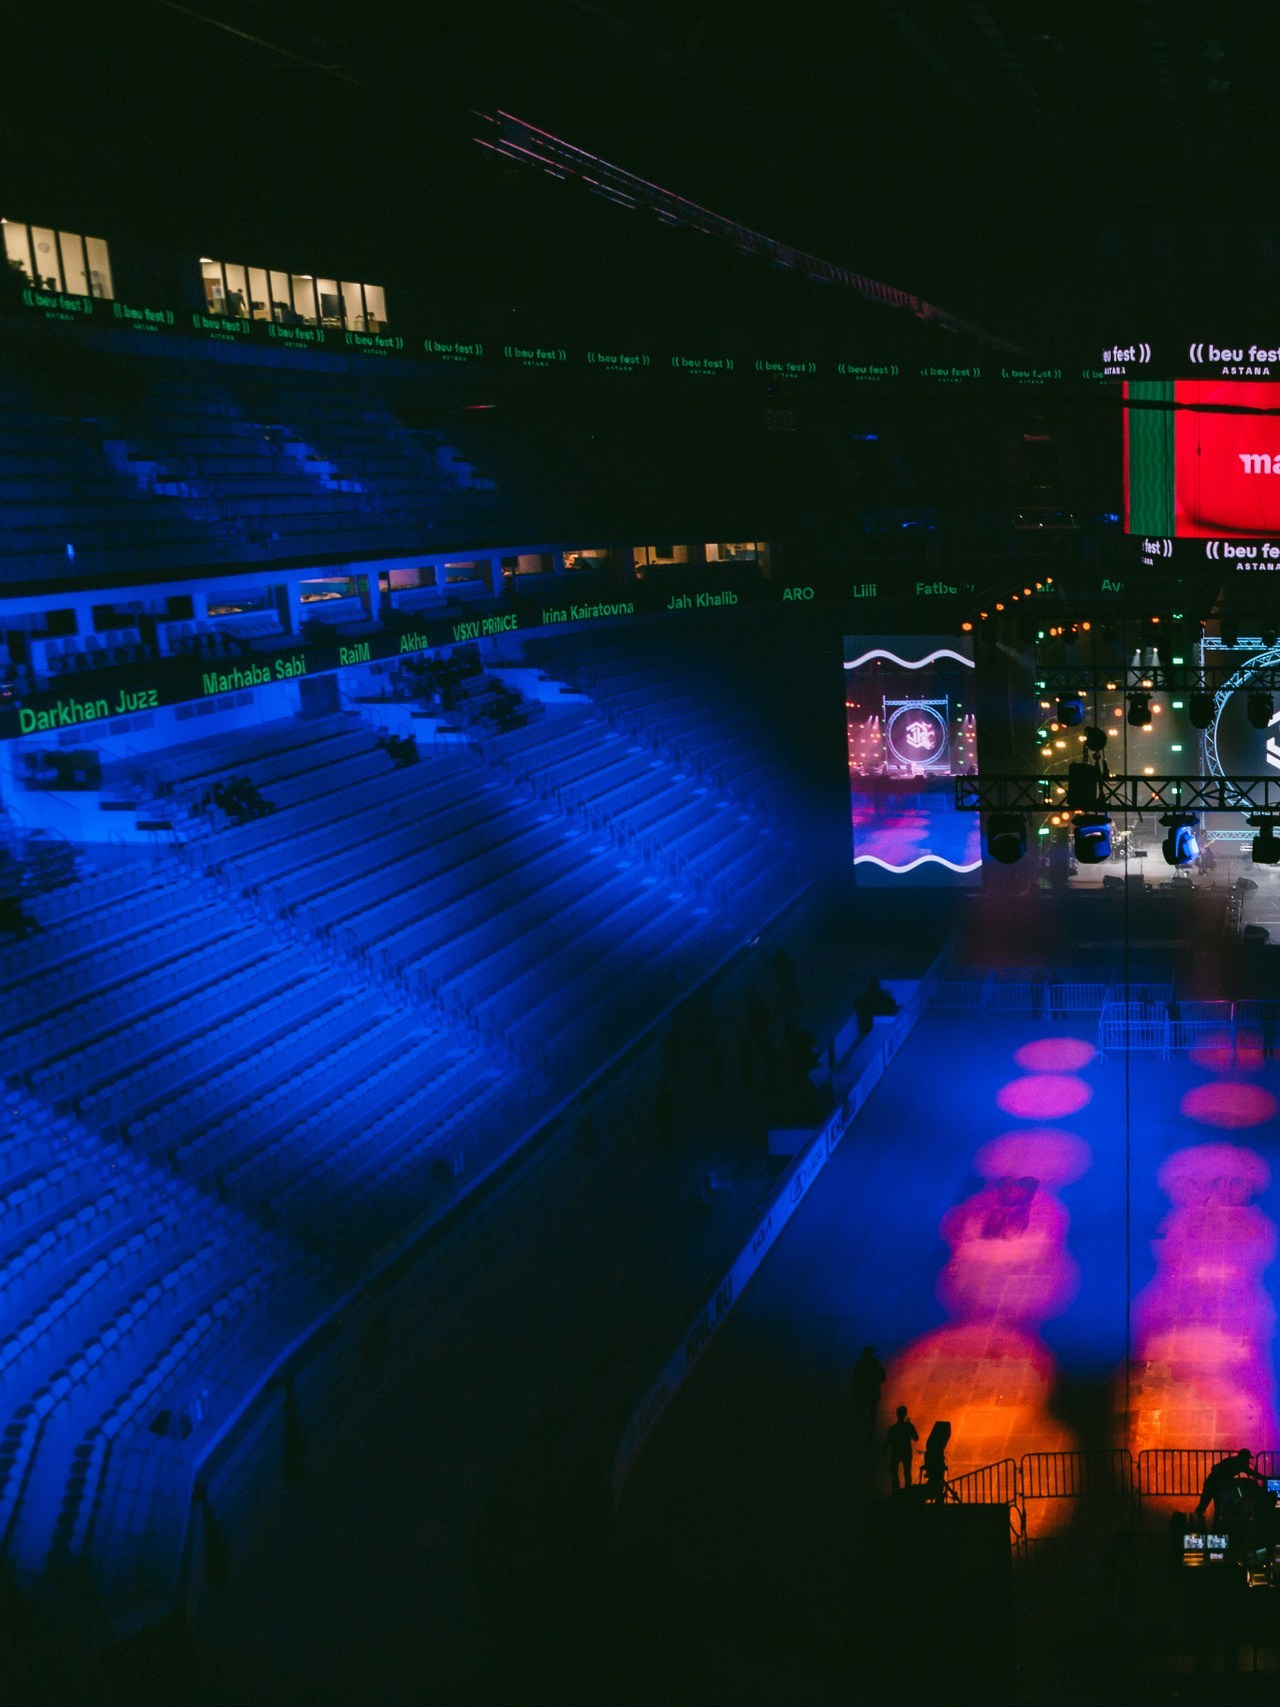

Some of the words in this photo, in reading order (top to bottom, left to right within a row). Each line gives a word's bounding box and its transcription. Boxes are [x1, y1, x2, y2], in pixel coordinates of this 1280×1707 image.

[59, 294, 82, 311] fest
[145, 310, 165, 322] fest
[222, 320, 241, 332] fest
[298, 329, 315, 340] fest
[375, 336, 394, 348] fest
[455, 342, 475, 355] fest
[536, 349, 557, 360] fest
[1113, 345, 1136, 362] fest
[1208, 344, 1244, 362] beu
[619, 354, 640, 365] fest
[703, 357, 724, 369] fest
[785, 361, 807, 372] fest
[869, 364, 889, 375] fest
[1221, 366, 1271, 376] ASTANA
[1145, 538, 1161, 555] fest
[1223, 542, 1257, 559] beu
[782, 587, 815, 601] ARO
[853, 583, 877, 598] Liili
[667, 593, 692, 610] Jah
[696, 590, 739, 608] Khalib
[542, 608, 568, 625] Irina
[570, 602, 635, 621] Kairatovna
[452, 619, 481, 642] V$XV
[482, 614, 519, 636] PRiNCE
[400, 632, 428, 653] Akha
[339, 642, 371, 666] RaiM
[203, 663, 272, 695] Marhaba
[275, 654, 307, 680] Sabi
[19, 697, 109, 734] Darkhan
[115, 689, 159, 714] Juzz
